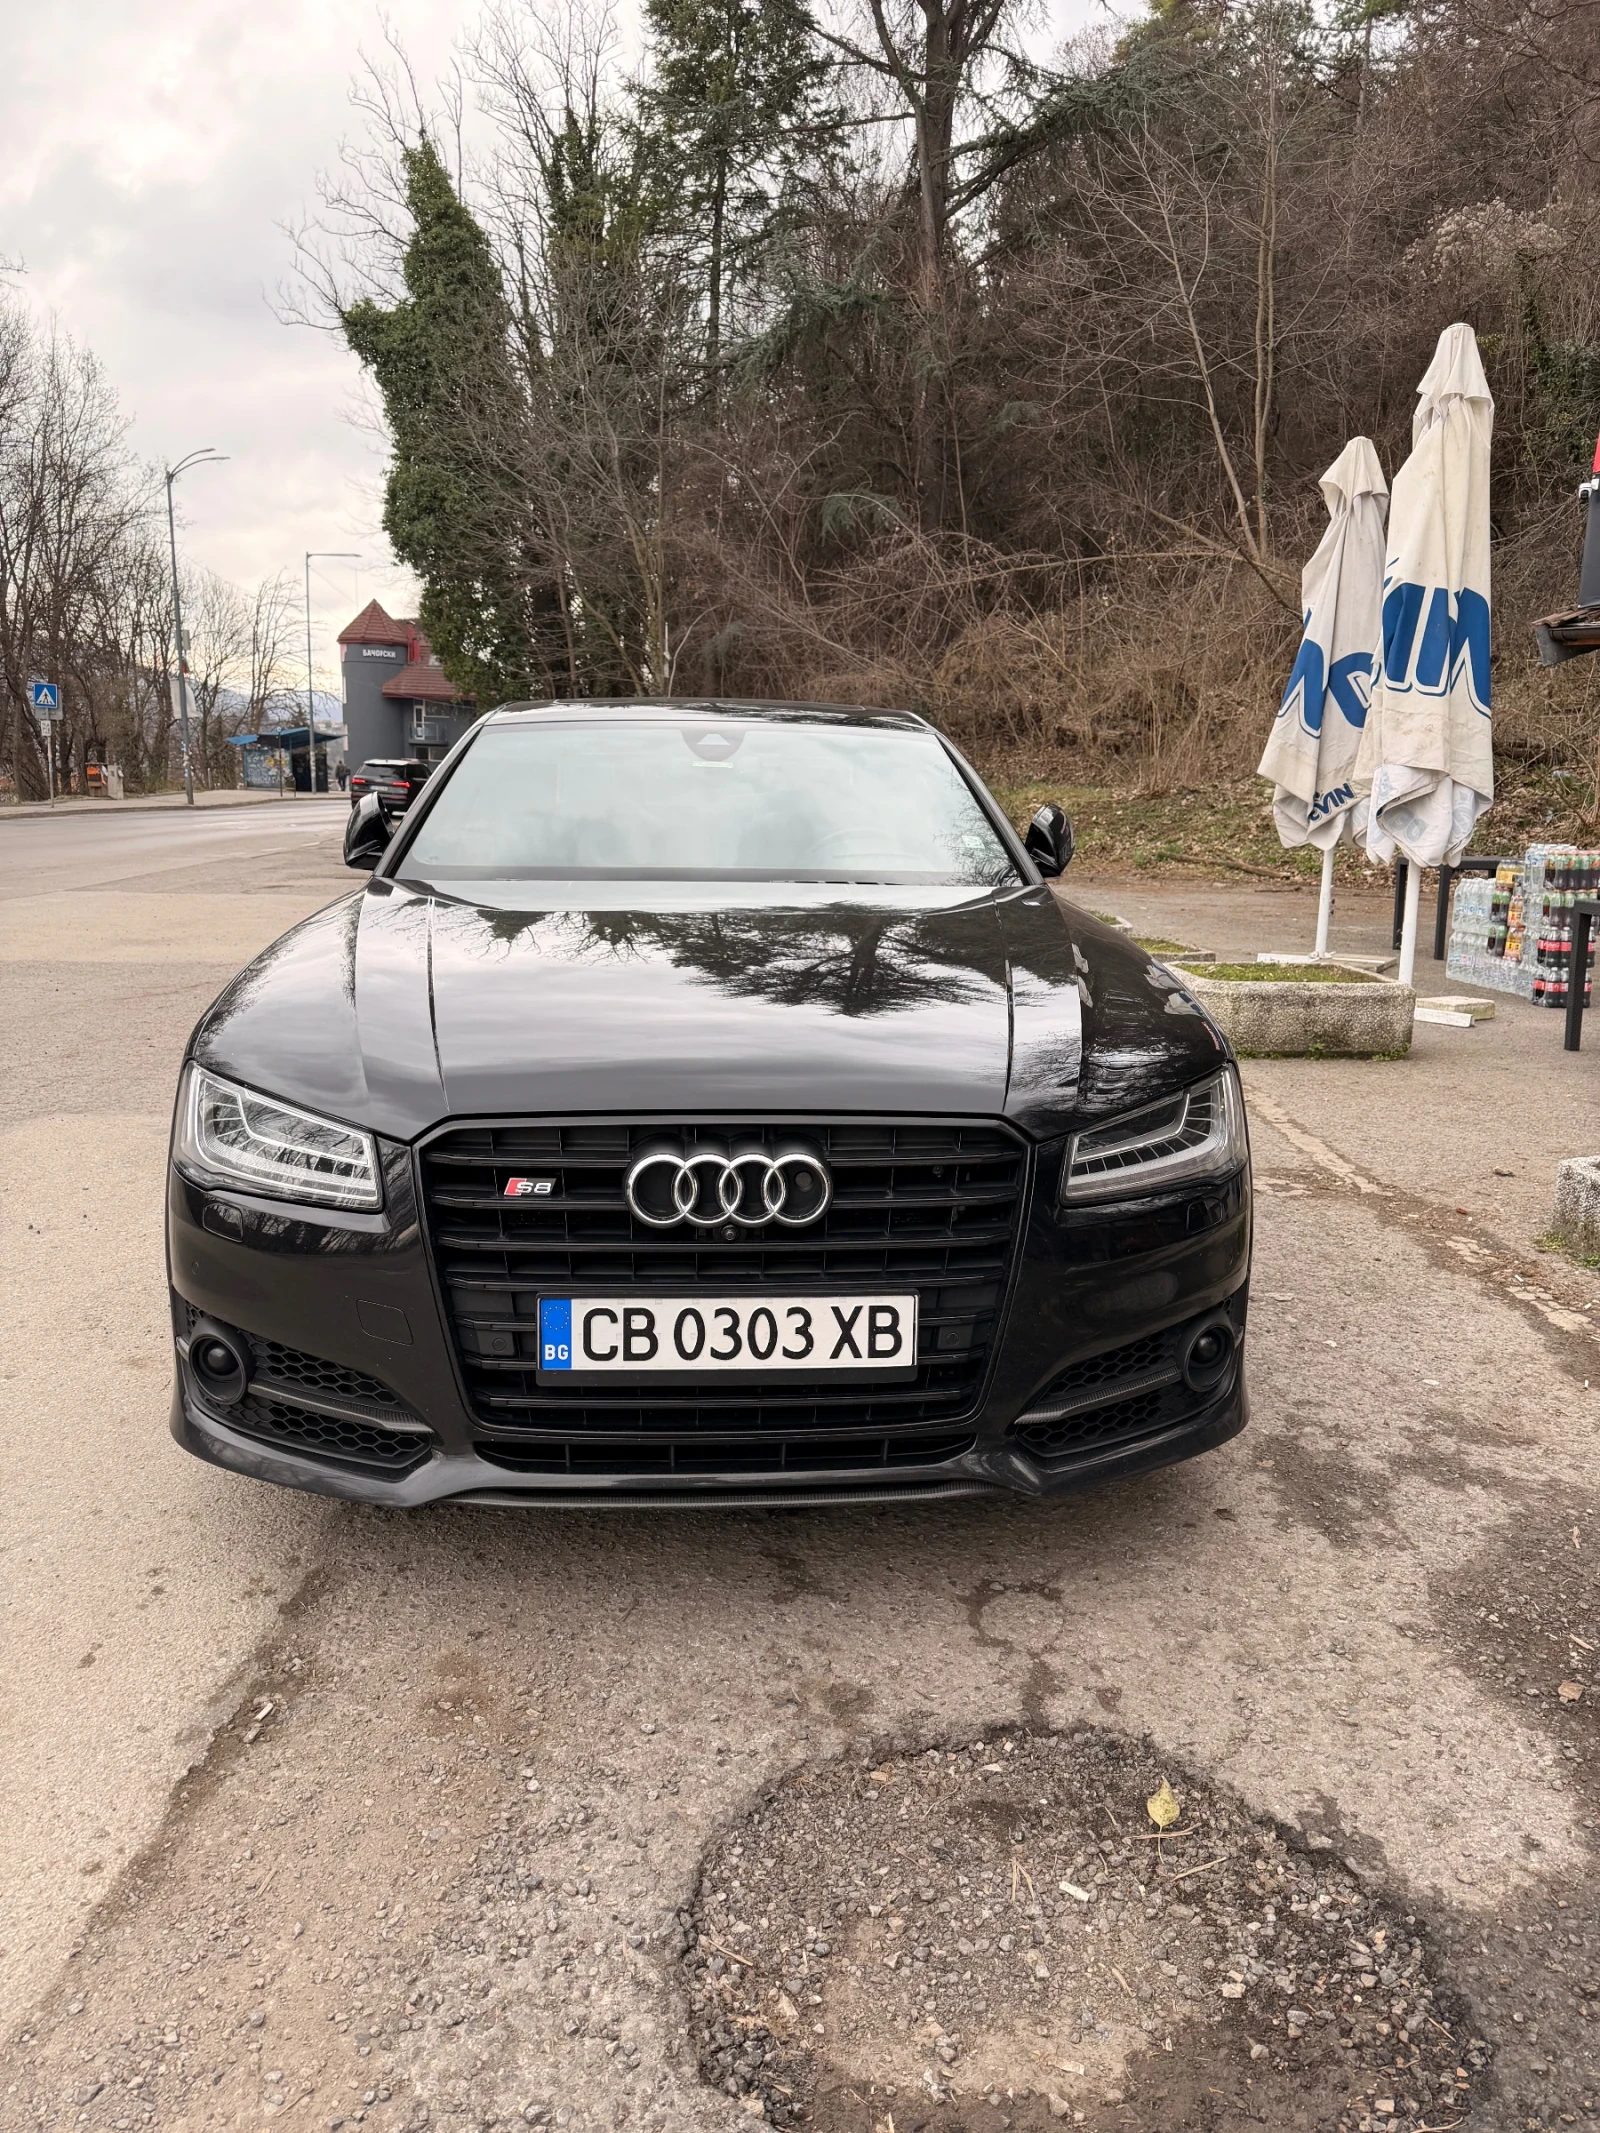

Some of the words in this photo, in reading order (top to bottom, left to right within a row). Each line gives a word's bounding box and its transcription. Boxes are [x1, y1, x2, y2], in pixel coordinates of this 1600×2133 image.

[362, 648, 396, 659] БАЧОРСКИ
[515, 1181, 552, 1194] S8
[582, 1307, 659, 1362] CB
[673, 1306, 815, 1361] 0303
[828, 1304, 904, 1360] XB
[544, 1344, 569, 1361] BG
